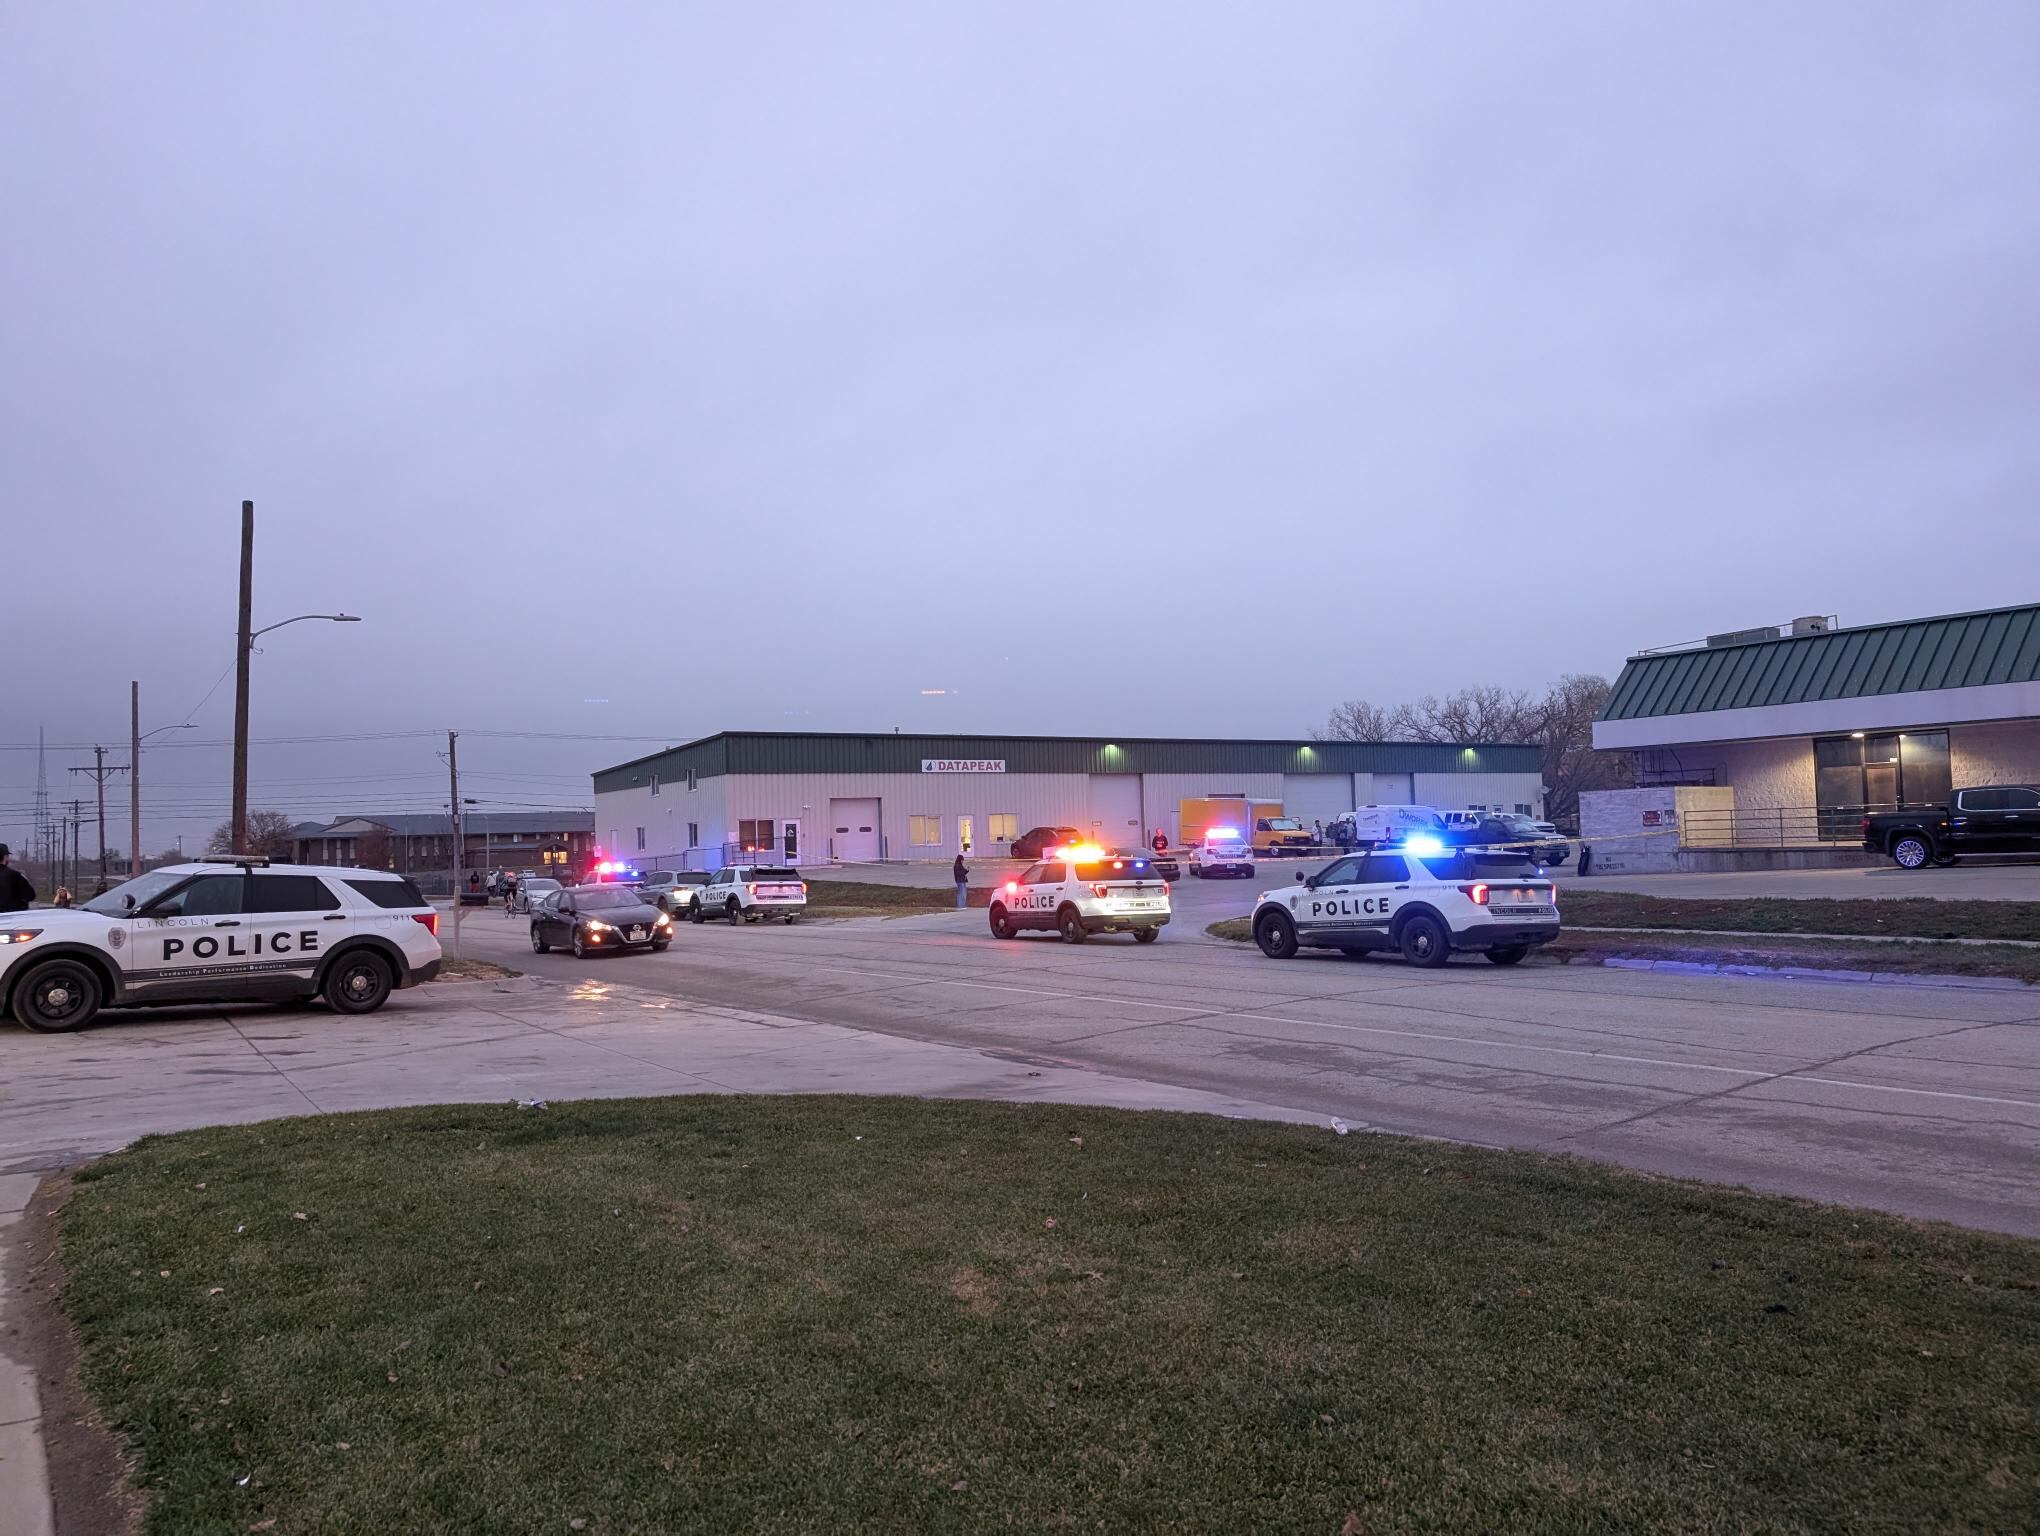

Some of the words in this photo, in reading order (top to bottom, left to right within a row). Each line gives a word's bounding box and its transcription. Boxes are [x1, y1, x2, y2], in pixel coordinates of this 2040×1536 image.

[938, 761, 1002, 771] DATAPEAK
[705, 891, 726, 901] POLICE
[1014, 896, 1055, 909] POLICE
[1312, 898, 1389, 916] POLICE
[137, 918, 210, 929] LINCOLN
[163, 931, 319, 961] POLICE
